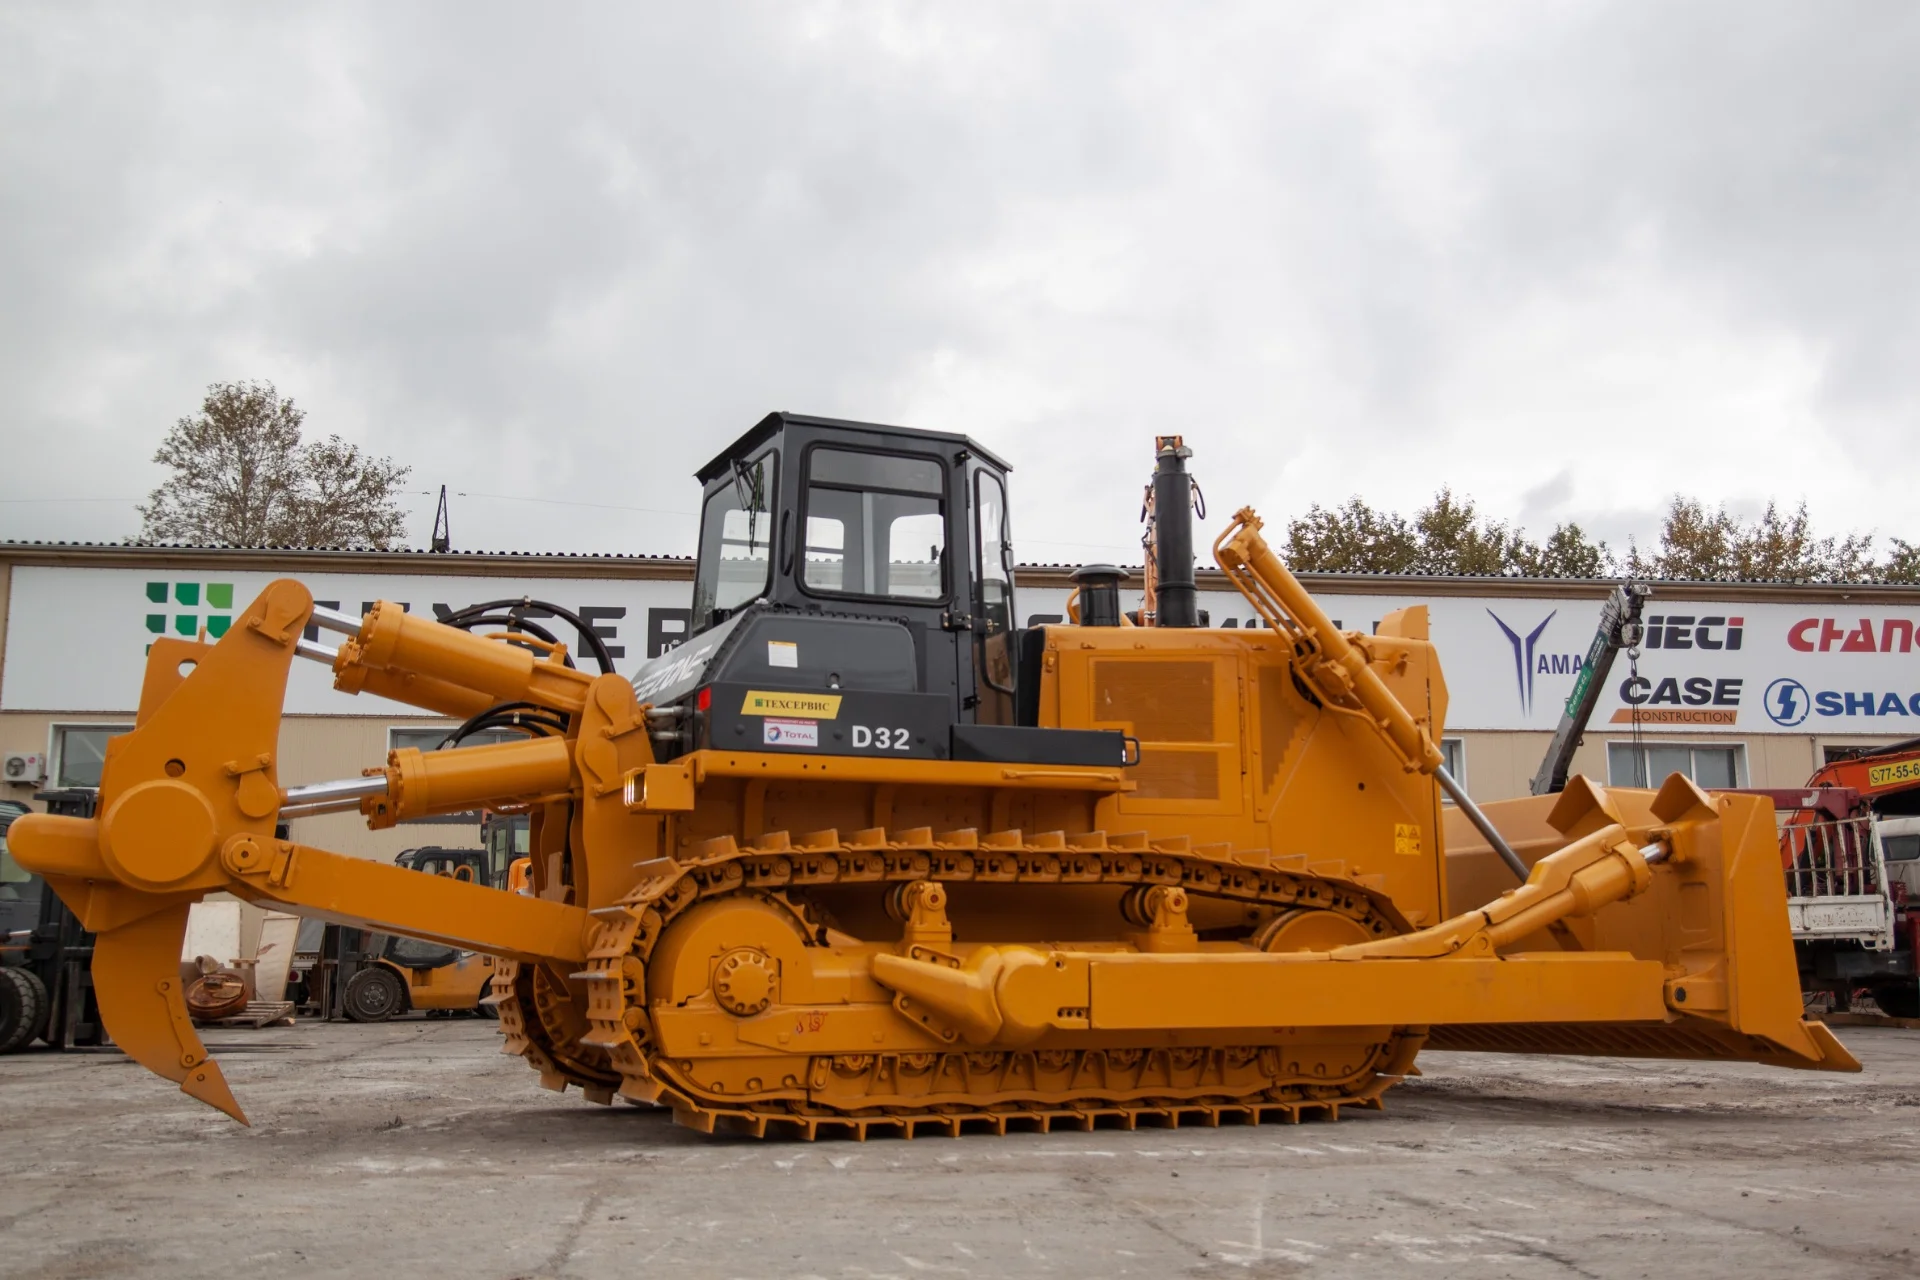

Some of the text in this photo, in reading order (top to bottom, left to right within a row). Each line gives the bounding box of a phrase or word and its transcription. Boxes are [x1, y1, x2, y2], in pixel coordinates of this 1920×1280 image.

[1787, 618, 1920, 653] CHAN
[1619, 676, 1743, 705] CASE
[765, 699, 830, 711] ТЕХСЕРВИС
[1632, 711, 1733, 723] CONSTRUCTION
[852, 725, 910, 750] D32
